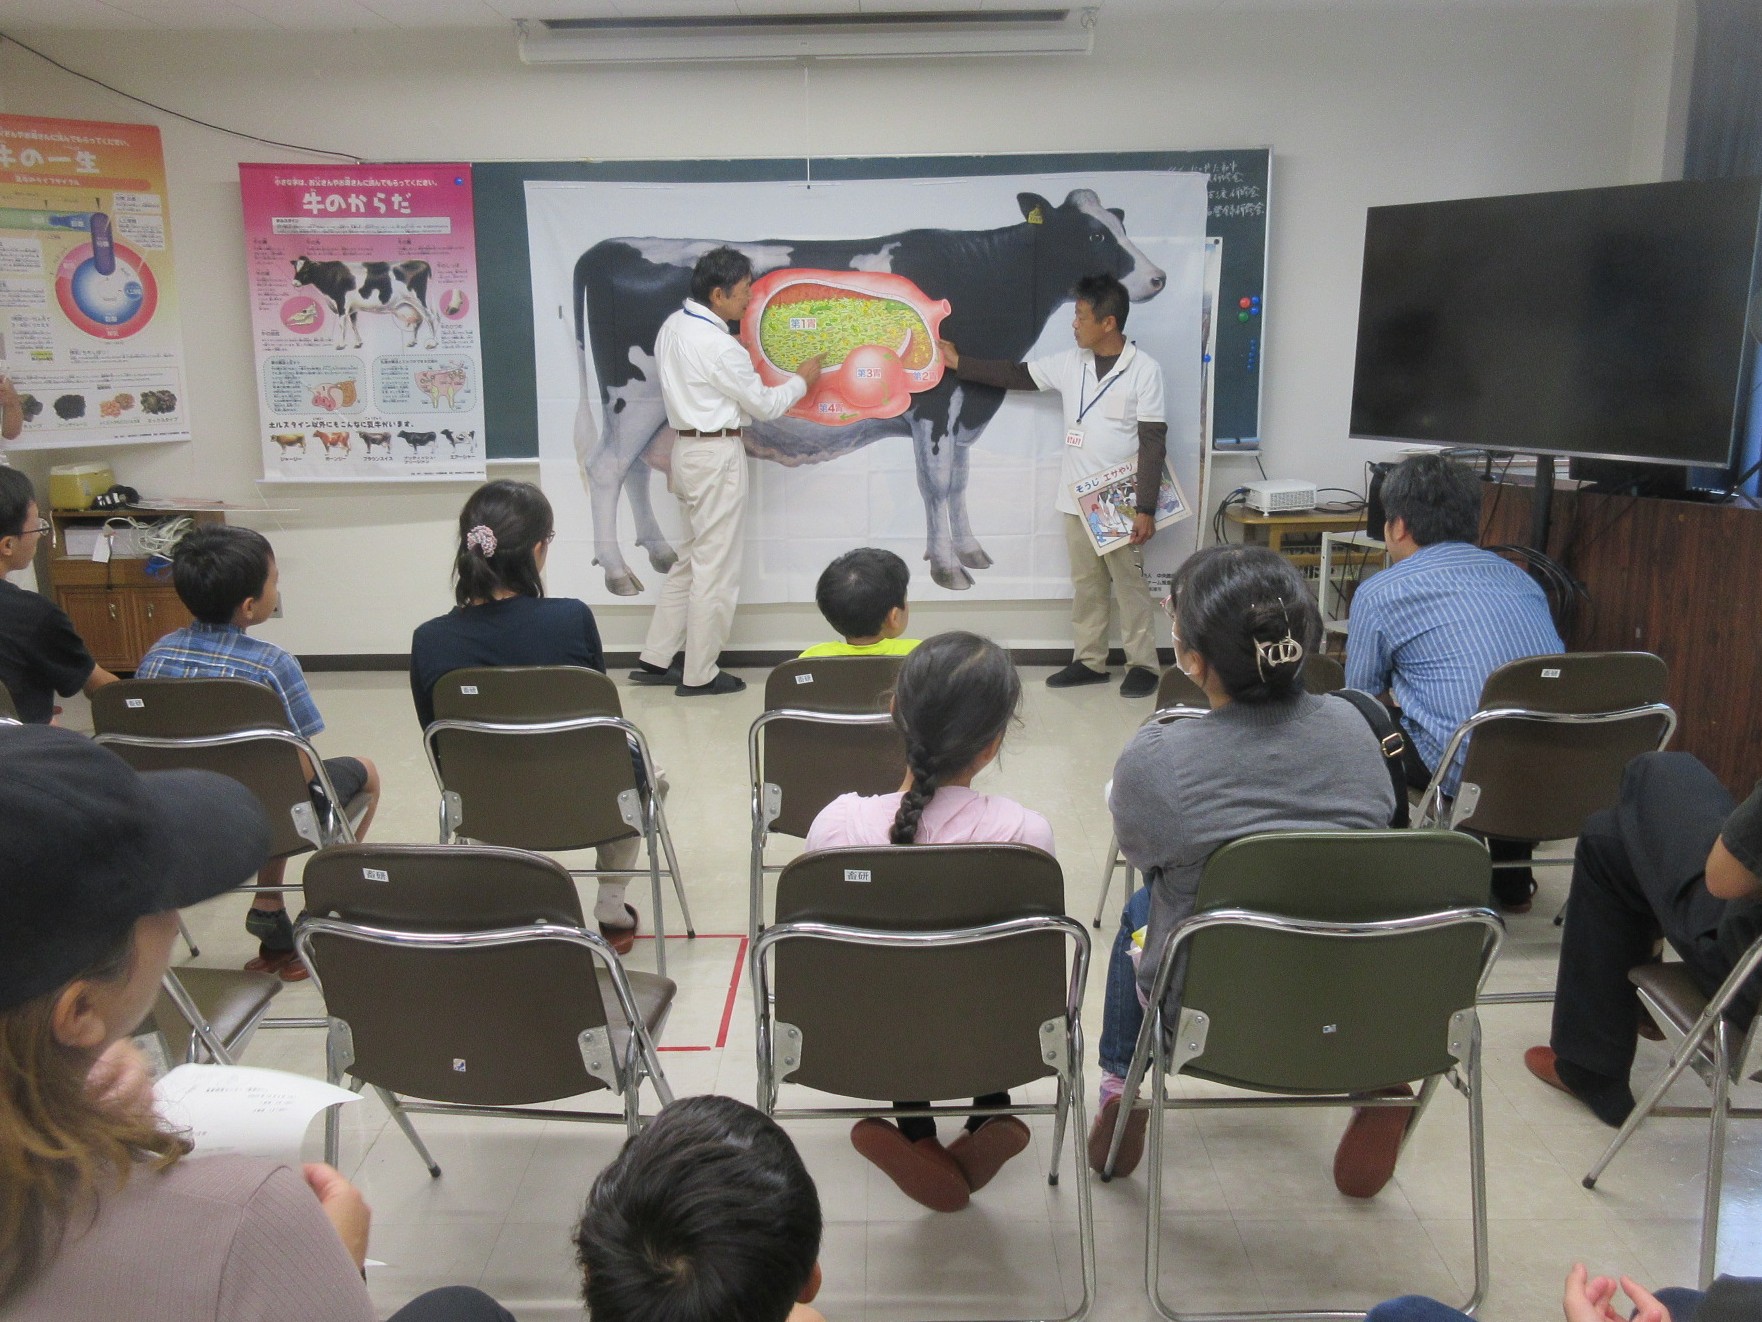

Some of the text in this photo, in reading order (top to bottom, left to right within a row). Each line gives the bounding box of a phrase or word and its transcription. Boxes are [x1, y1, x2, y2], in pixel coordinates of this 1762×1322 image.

[302, 191, 411, 215] 牛のからだ
[790, 318, 816, 330] 第1胃
[857, 368, 881, 378] 第3胃
[913, 371, 937, 382] 第2胃
[819, 403, 844, 414] 第4胃
[1075, 463, 1133, 493] そうじ エサやり
